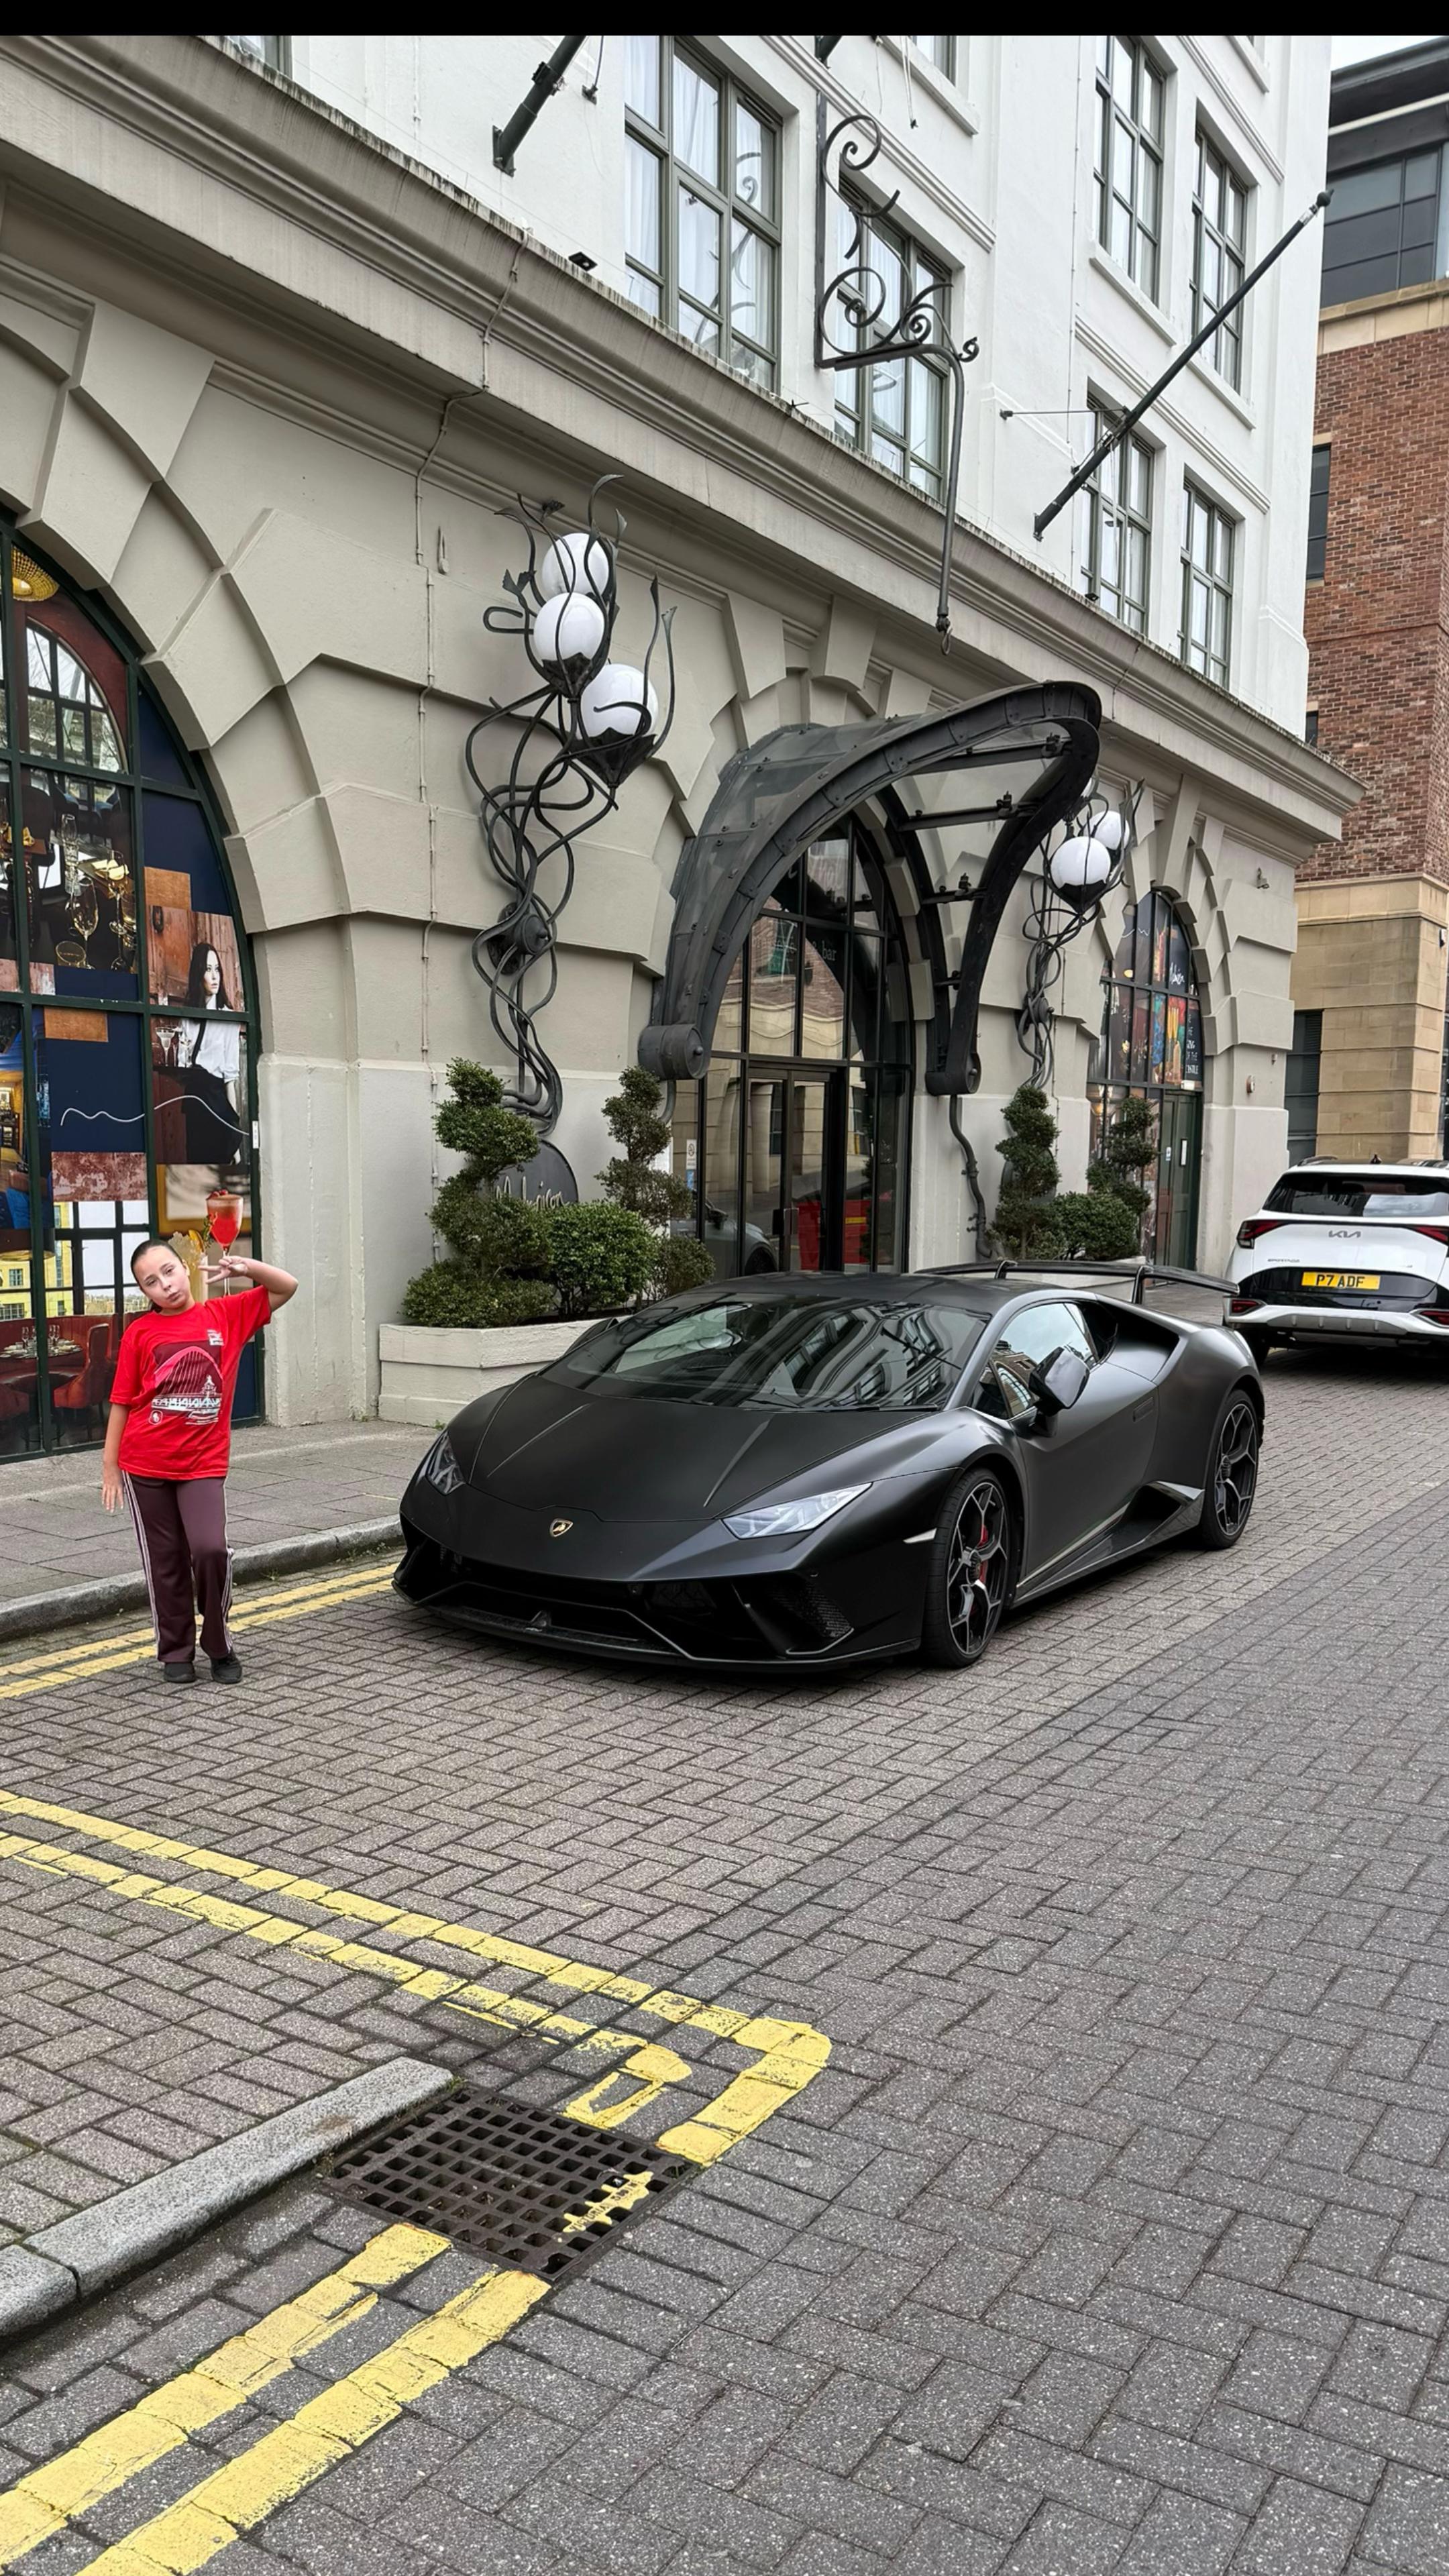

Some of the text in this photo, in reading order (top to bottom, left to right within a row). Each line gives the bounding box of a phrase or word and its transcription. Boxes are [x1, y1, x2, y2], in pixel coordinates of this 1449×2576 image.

[822, 941, 837, 961] bar
[1328, 1230, 1361, 1238] KIA
[1316, 1274, 1366, 1287] P7 ADF
